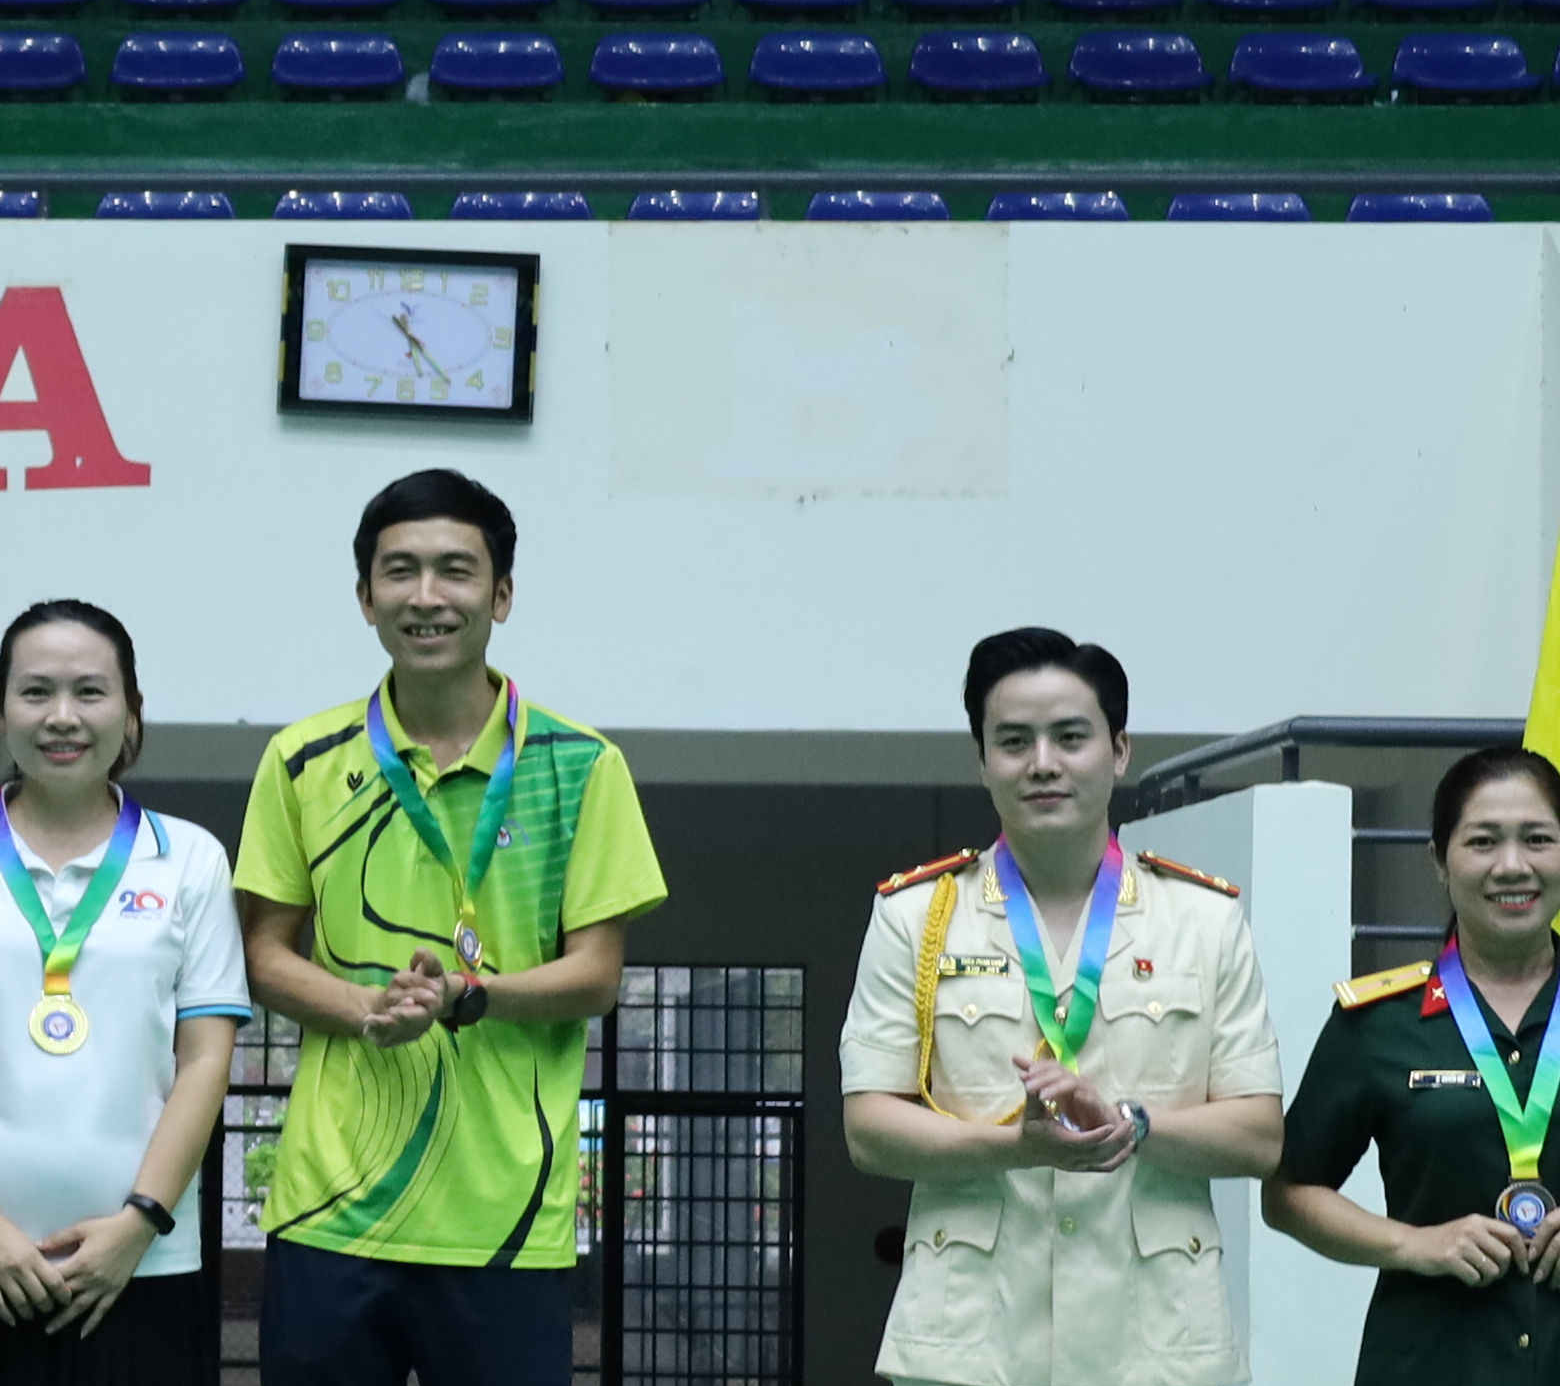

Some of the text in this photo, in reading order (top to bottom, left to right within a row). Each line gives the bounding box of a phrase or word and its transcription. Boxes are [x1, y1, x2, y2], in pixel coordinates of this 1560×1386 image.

[326, 279, 350, 301] 10
[399, 268, 425, 292] 12
[470, 283, 489, 306] 2
[493, 326, 512, 350] 3
[363, 375, 383, 399] 7
[430, 377, 448, 401] 5
[465, 369, 484, 392] 4
